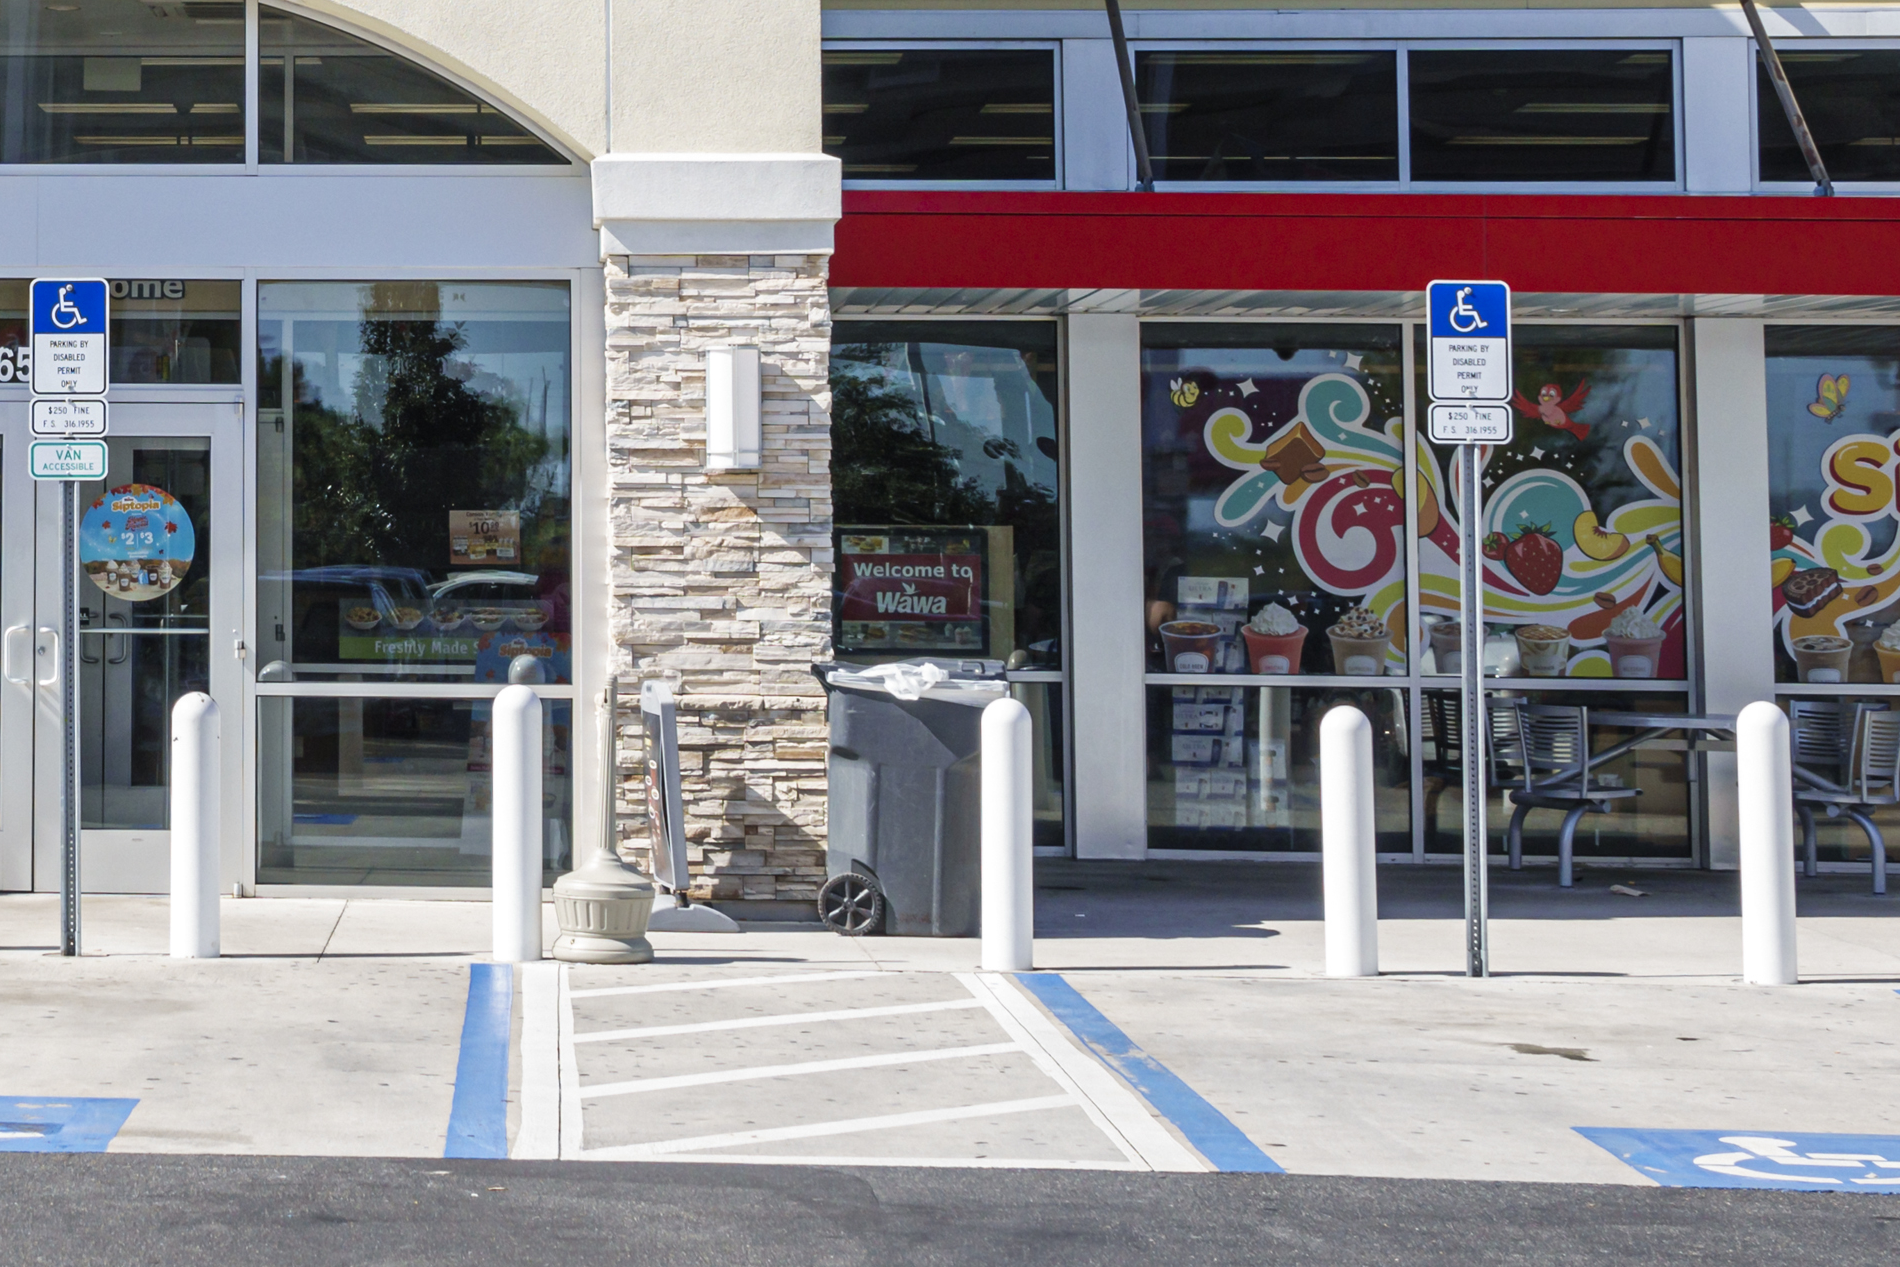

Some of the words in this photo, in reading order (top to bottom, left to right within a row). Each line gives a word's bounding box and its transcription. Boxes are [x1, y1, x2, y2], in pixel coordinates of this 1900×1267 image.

[49, 340, 78, 348] PARKING
[79, 340, 89, 348] BY
[1448, 344, 1478, 353] PARKING
[1480, 344, 1489, 353] BY
[53, 353, 86, 362] DISABLED
[1452, 358, 1486, 366] DISABLED
[57, 367, 81, 375] PERMIT
[1457, 371, 1482, 380] PERMIT
[61, 380, 78, 388] ONLY
[1461, 385, 1479, 394] ONLY
[48, 406, 68, 415] $250
[73, 406, 90, 415] FINE
[1448, 412, 1468, 421] $250
[1475, 412, 1492, 421] FINE
[64, 419, 95, 428] 316.1955
[1465, 426, 1497, 434] 316.1955
[55, 450, 81, 461] VAN
[42, 462, 94, 471] ACCESSIBLE
[111, 500, 160, 512] Siptopia
[121, 532, 135, 545] $2
[140, 531, 154, 545] $3
[853, 562, 945, 578] Welcome
[951, 563, 972, 578] to
[876, 591, 947, 614] Wawa
[375, 640, 426, 656] Freshly
[431, 640, 468, 655] Made
